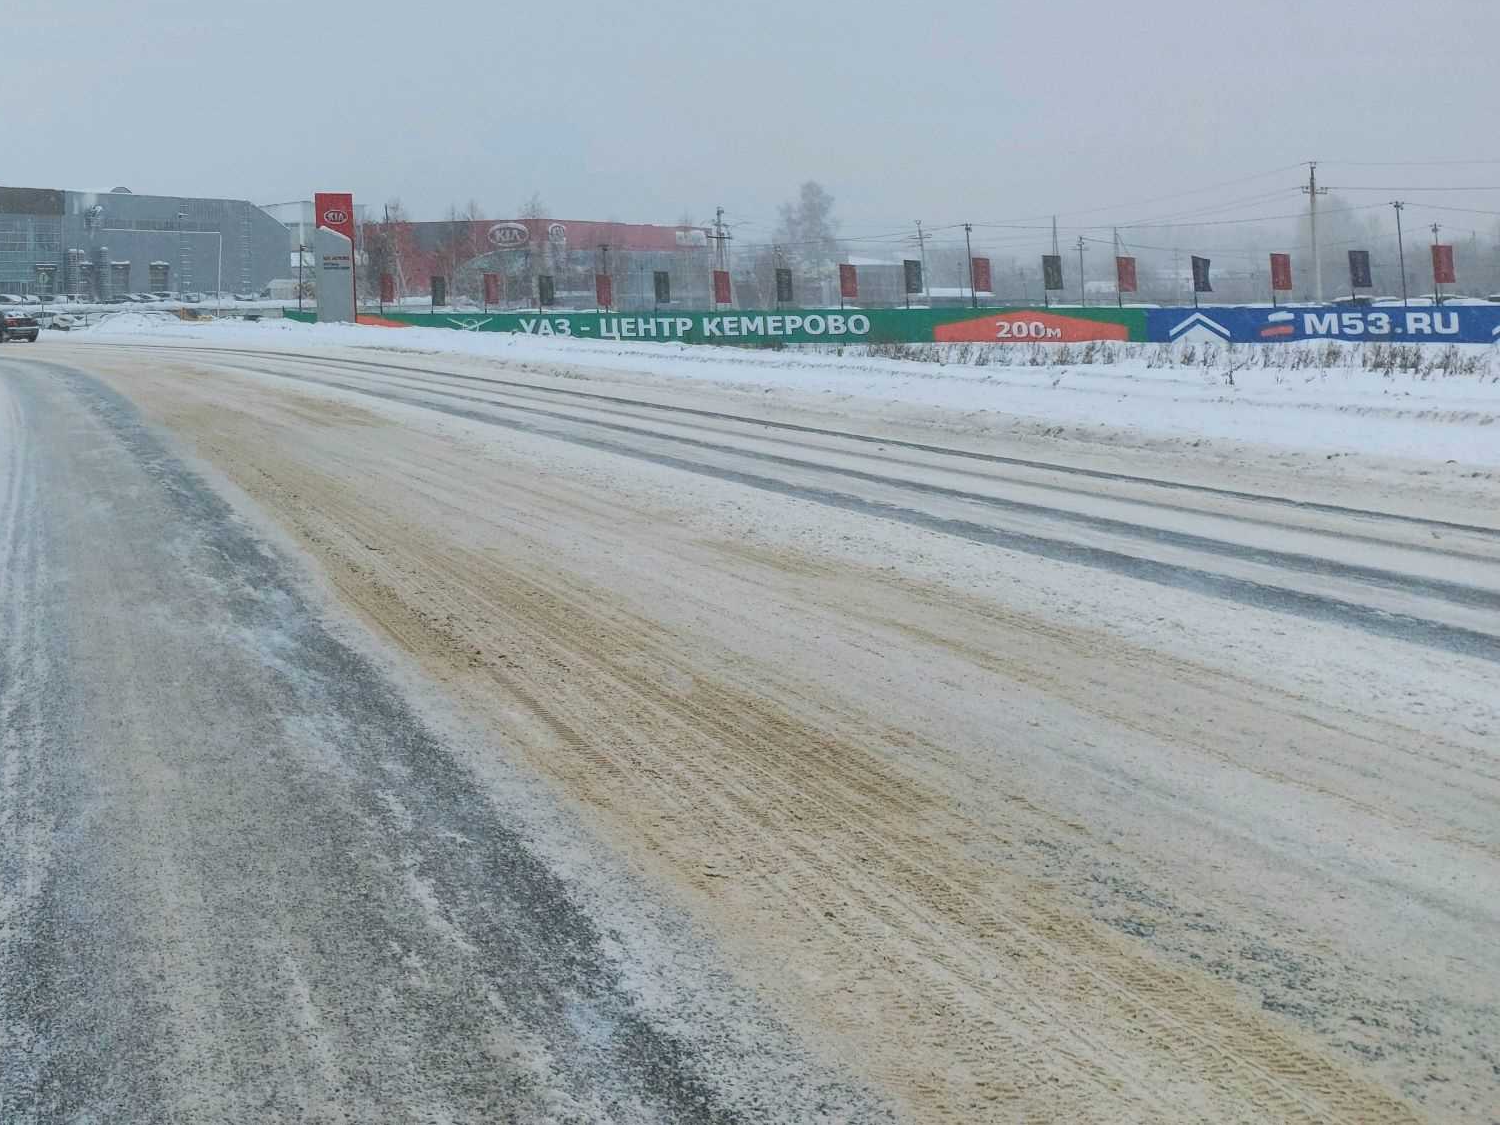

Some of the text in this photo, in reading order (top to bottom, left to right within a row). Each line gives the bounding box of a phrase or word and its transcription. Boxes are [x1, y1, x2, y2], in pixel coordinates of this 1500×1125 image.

[518, 318, 572, 337] УАЗ
[600, 317, 693, 341] ЦЕНТР
[702, 314, 871, 337] КЕМЕРОВО
[1303, 312, 1460, 335] M53.RU
